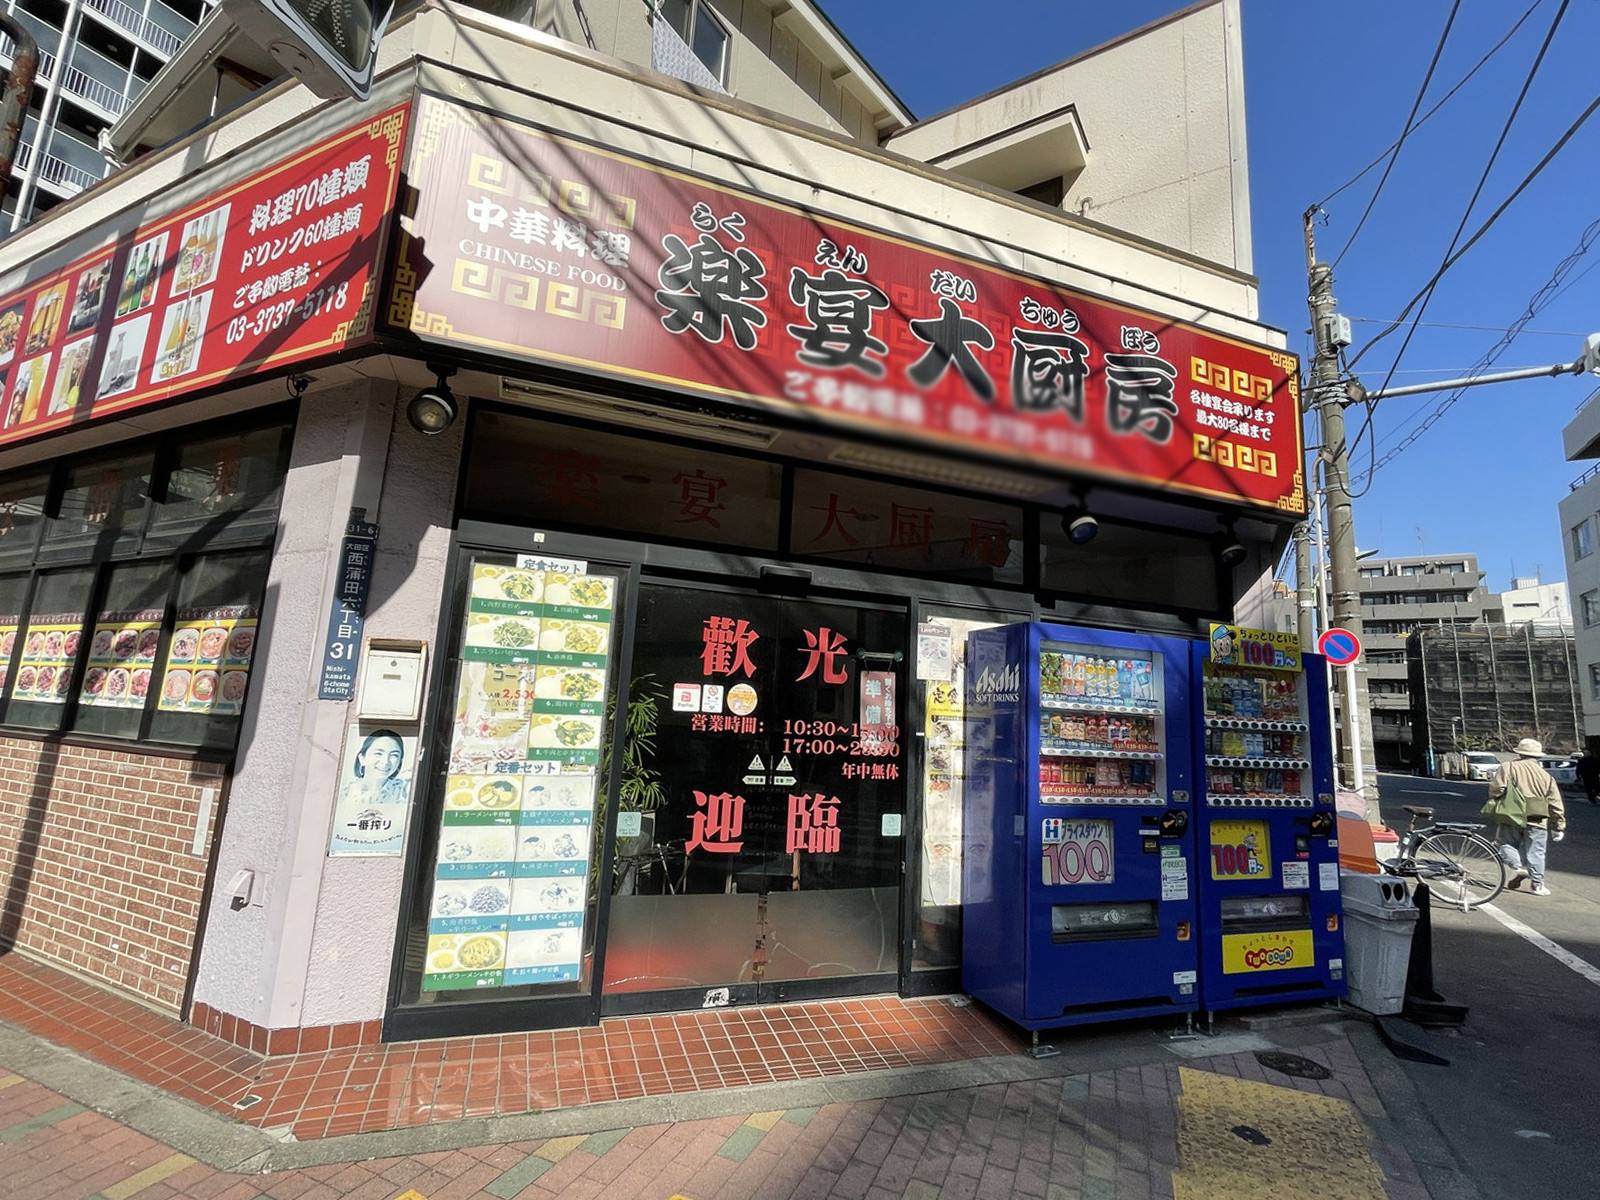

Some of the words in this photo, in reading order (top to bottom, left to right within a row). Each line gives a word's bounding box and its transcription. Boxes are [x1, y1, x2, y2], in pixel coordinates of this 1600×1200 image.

[248, 154, 371, 236] 料理70種類
[240, 203, 363, 273] ドリンク60種類
[466, 196, 631, 268] 中華料理
[458, 238, 561, 276] CHINESE
[567, 265, 627, 291] FOOD
[690, 202, 747, 243] らく
[815, 237, 868, 275] えん
[929, 267, 977, 302] だい
[1020, 296, 1080, 335] ちゅう
[1121, 325, 1160, 352] ぼう
[655, 233, 1178, 445] 楽宴大厨房
[1190, 389, 1275, 424] 各種宴会承ります
[1196, 408, 1271, 441] 最大80名様まで
[348, 524, 375, 535] 31-6
[345, 543, 370, 552] 大田区
[329, 642, 353, 660] 31
[796, 627, 848, 684] 光
[335, 687, 348, 695] City
[976, 663, 1020, 692] Asahi
[976, 693, 992, 702] SOFT
[993, 693, 1020, 702] DRINKS
[494, 761, 556, 774] 定番セット
[842, 762, 899, 780] 年中無休
[346, 819, 392, 831] 一番搾り
[684, 790, 746, 856] 迎
[786, 793, 841, 855] 臨
